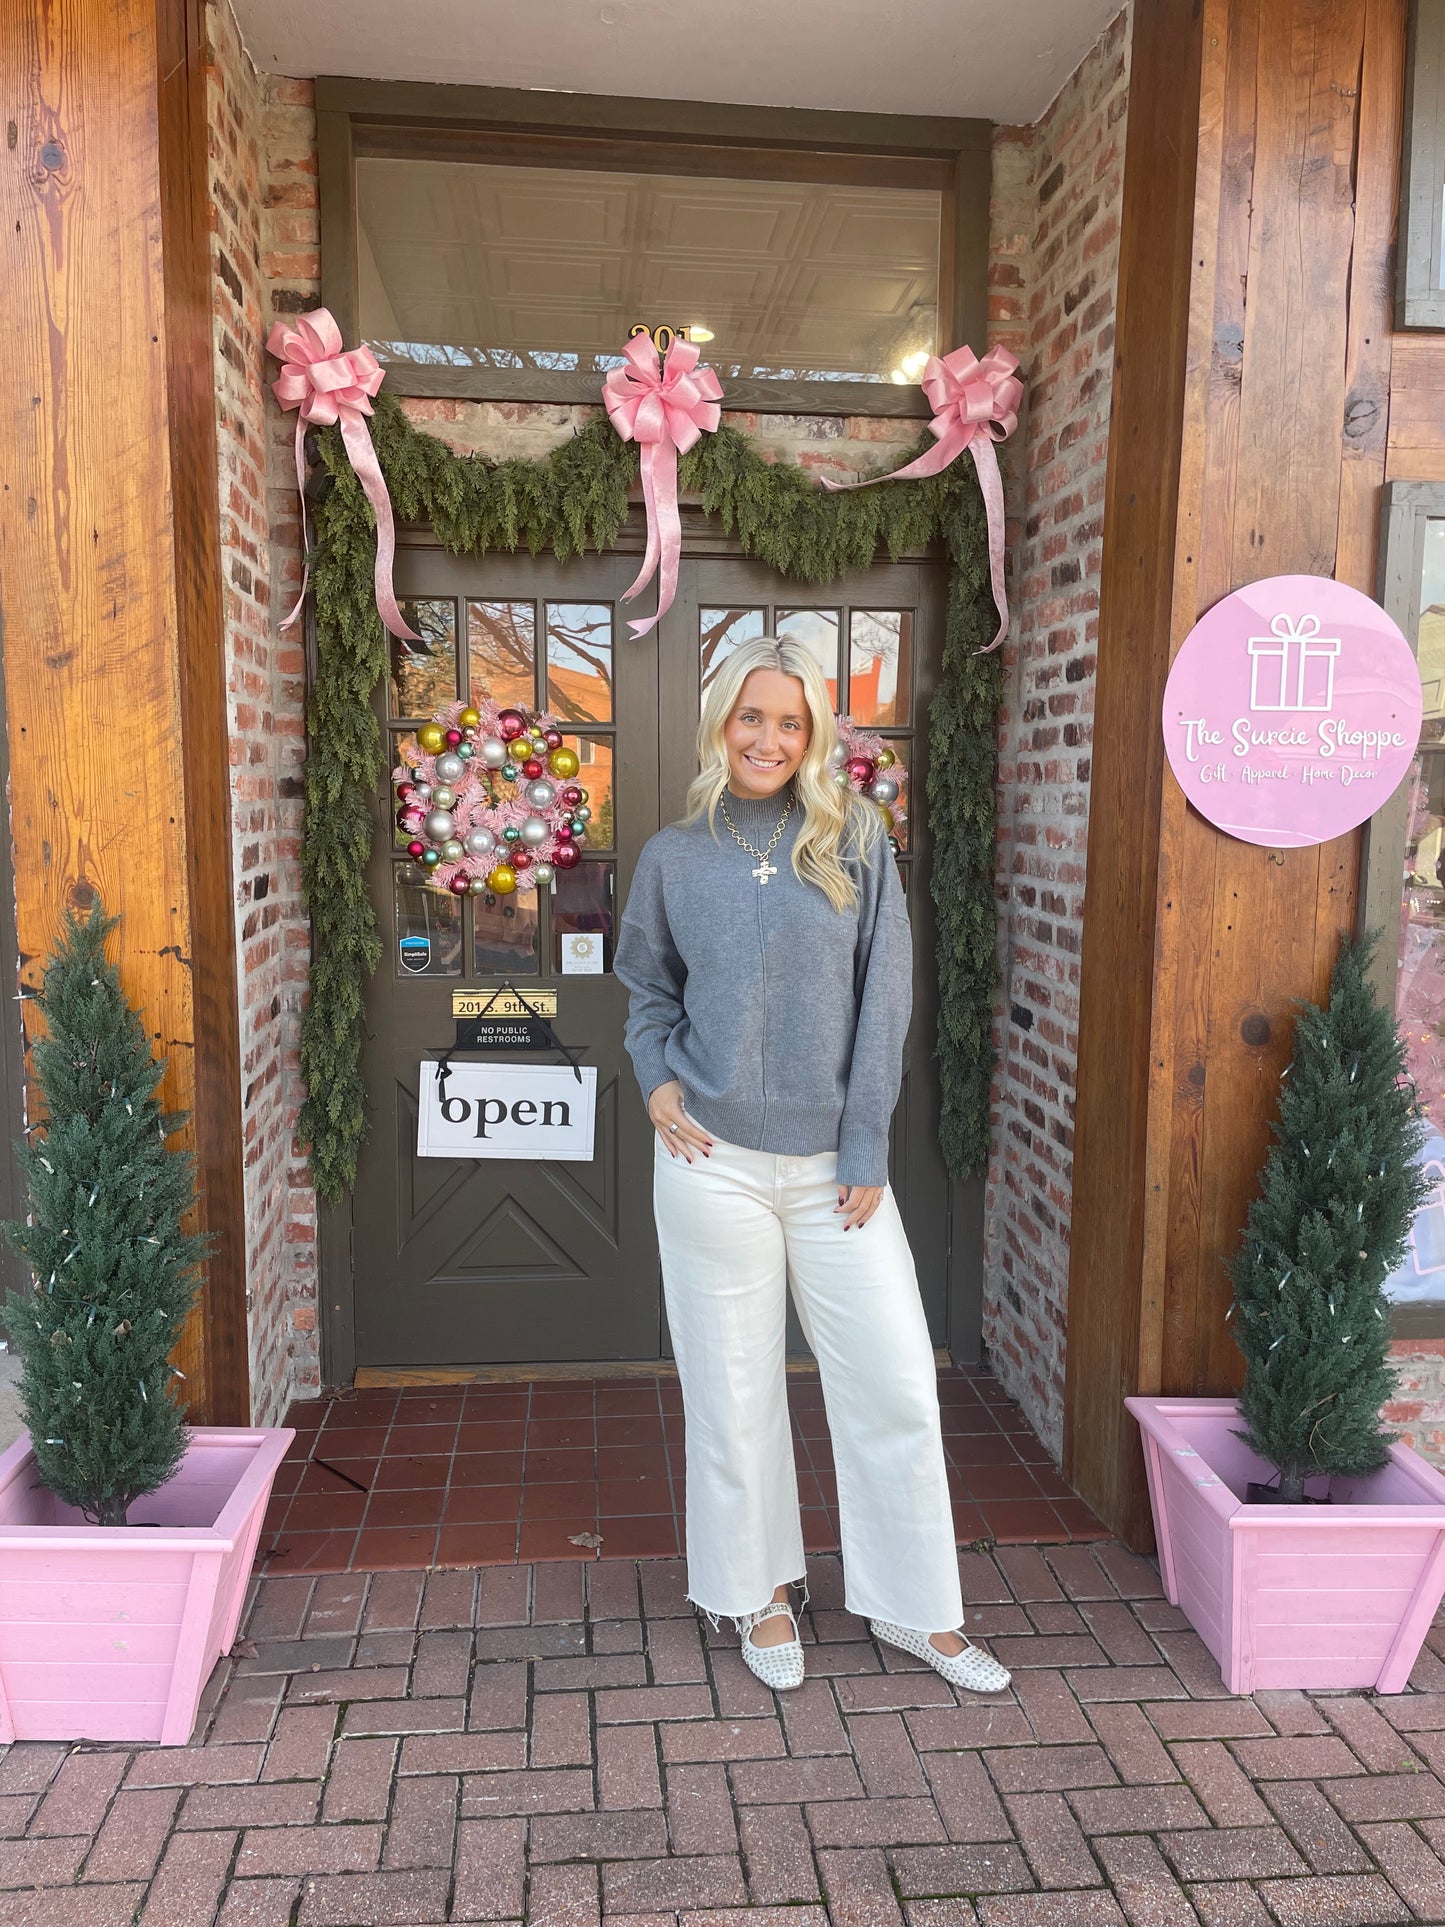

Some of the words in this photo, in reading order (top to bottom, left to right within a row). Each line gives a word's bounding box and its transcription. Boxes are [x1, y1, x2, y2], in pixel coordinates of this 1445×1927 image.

[1178, 718, 1225, 762] The
[1231, 718, 1311, 757] Surcie
[1317, 719, 1406, 760] Shoppe
[1199, 763, 1228, 783] Gift
[1240, 765, 1288, 785] Apparel
[1300, 765, 1335, 785] Home
[1340, 765, 1376, 786] Decor
[458, 1001, 481, 1013] 201
[504, 1001, 527, 1013] 9th
[532, 1001, 550, 1013] St.
[481, 1026, 495, 1035] NO
[496, 1026, 528, 1035] PUBLIC
[476, 1035, 531, 1044] RESTROOMS
[440, 1096, 574, 1139] open
